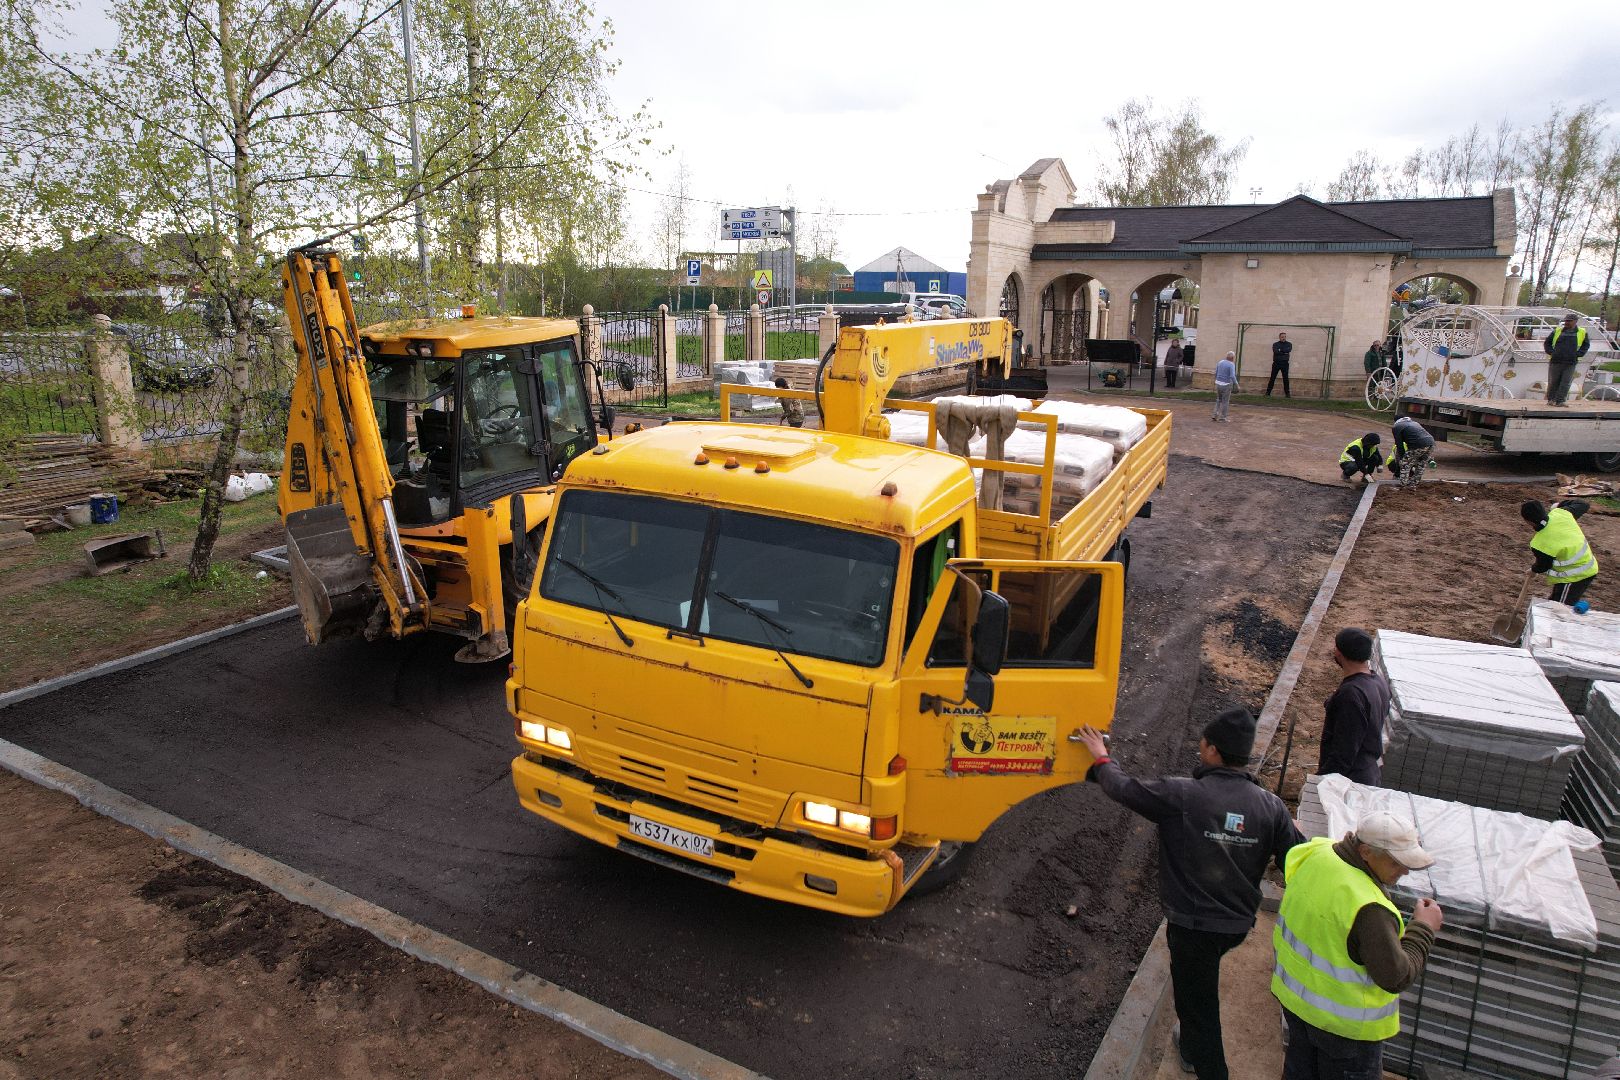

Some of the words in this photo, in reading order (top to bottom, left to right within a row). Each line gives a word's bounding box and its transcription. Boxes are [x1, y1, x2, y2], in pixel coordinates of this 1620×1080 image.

[690, 261, 699, 276] P
[942, 706, 986, 716] КАМА
[997, 731, 1017, 740] ВАМ
[693, 836, 708, 850] 07
